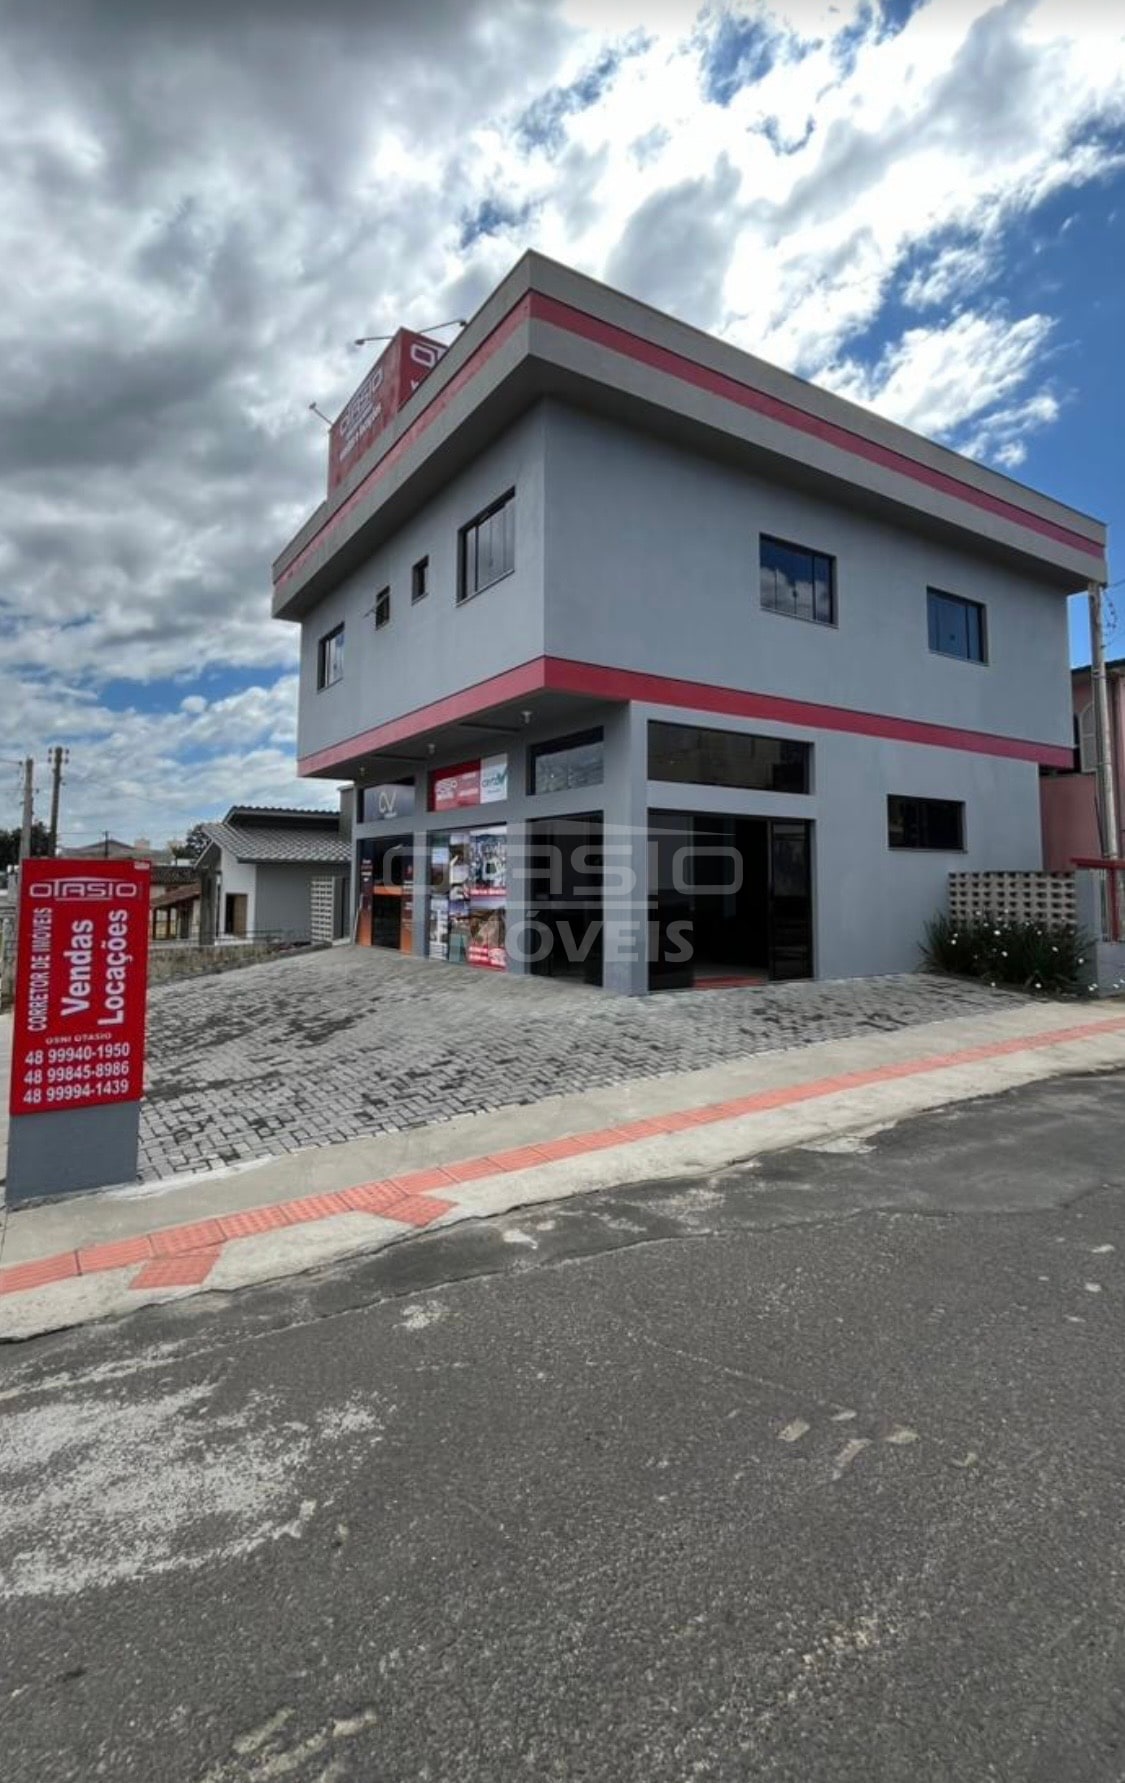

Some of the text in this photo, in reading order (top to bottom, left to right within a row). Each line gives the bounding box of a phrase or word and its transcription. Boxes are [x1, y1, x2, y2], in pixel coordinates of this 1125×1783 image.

[29, 877, 137, 898] OTASIO
[31, 955, 50, 968] DE
[61, 920, 93, 1015] Vendas
[98, 910, 132, 1025] Locações
[28, 973, 48, 1030] CORRETOR
[25, 1042, 130, 1065] 48 99940-1950
[24, 1060, 129, 1085] 48 99845-8986
[23, 1079, 129, 1104] 48 99994-1439
